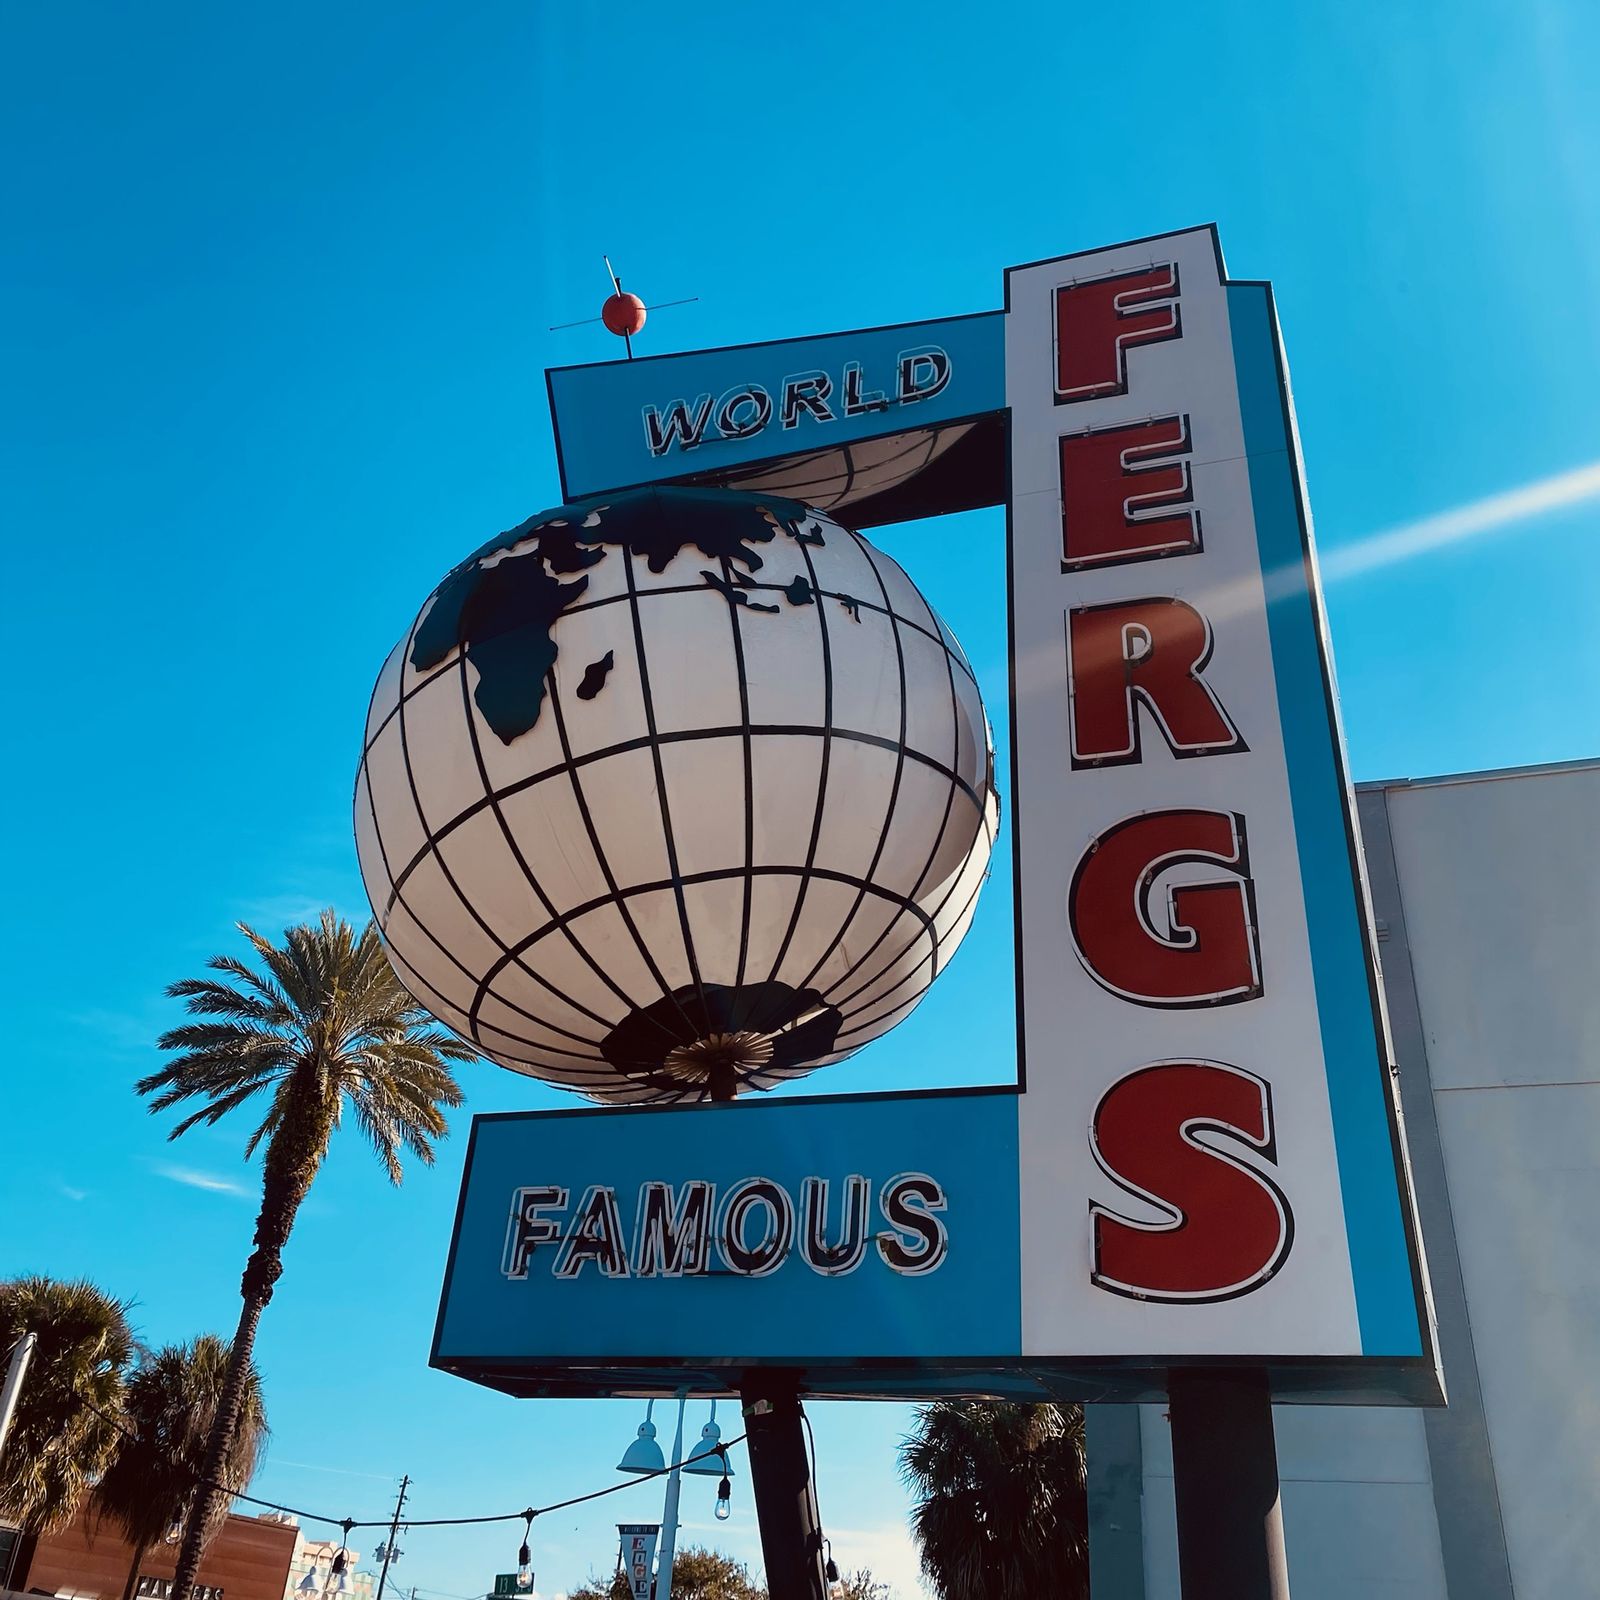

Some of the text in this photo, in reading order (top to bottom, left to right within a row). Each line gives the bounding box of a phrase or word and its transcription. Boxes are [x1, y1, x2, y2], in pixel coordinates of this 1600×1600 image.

[642, 345, 952, 457] WORLD
[1051, 262, 1294, 1304] FERGS
[500, 1171, 949, 1280] FAMOUS
